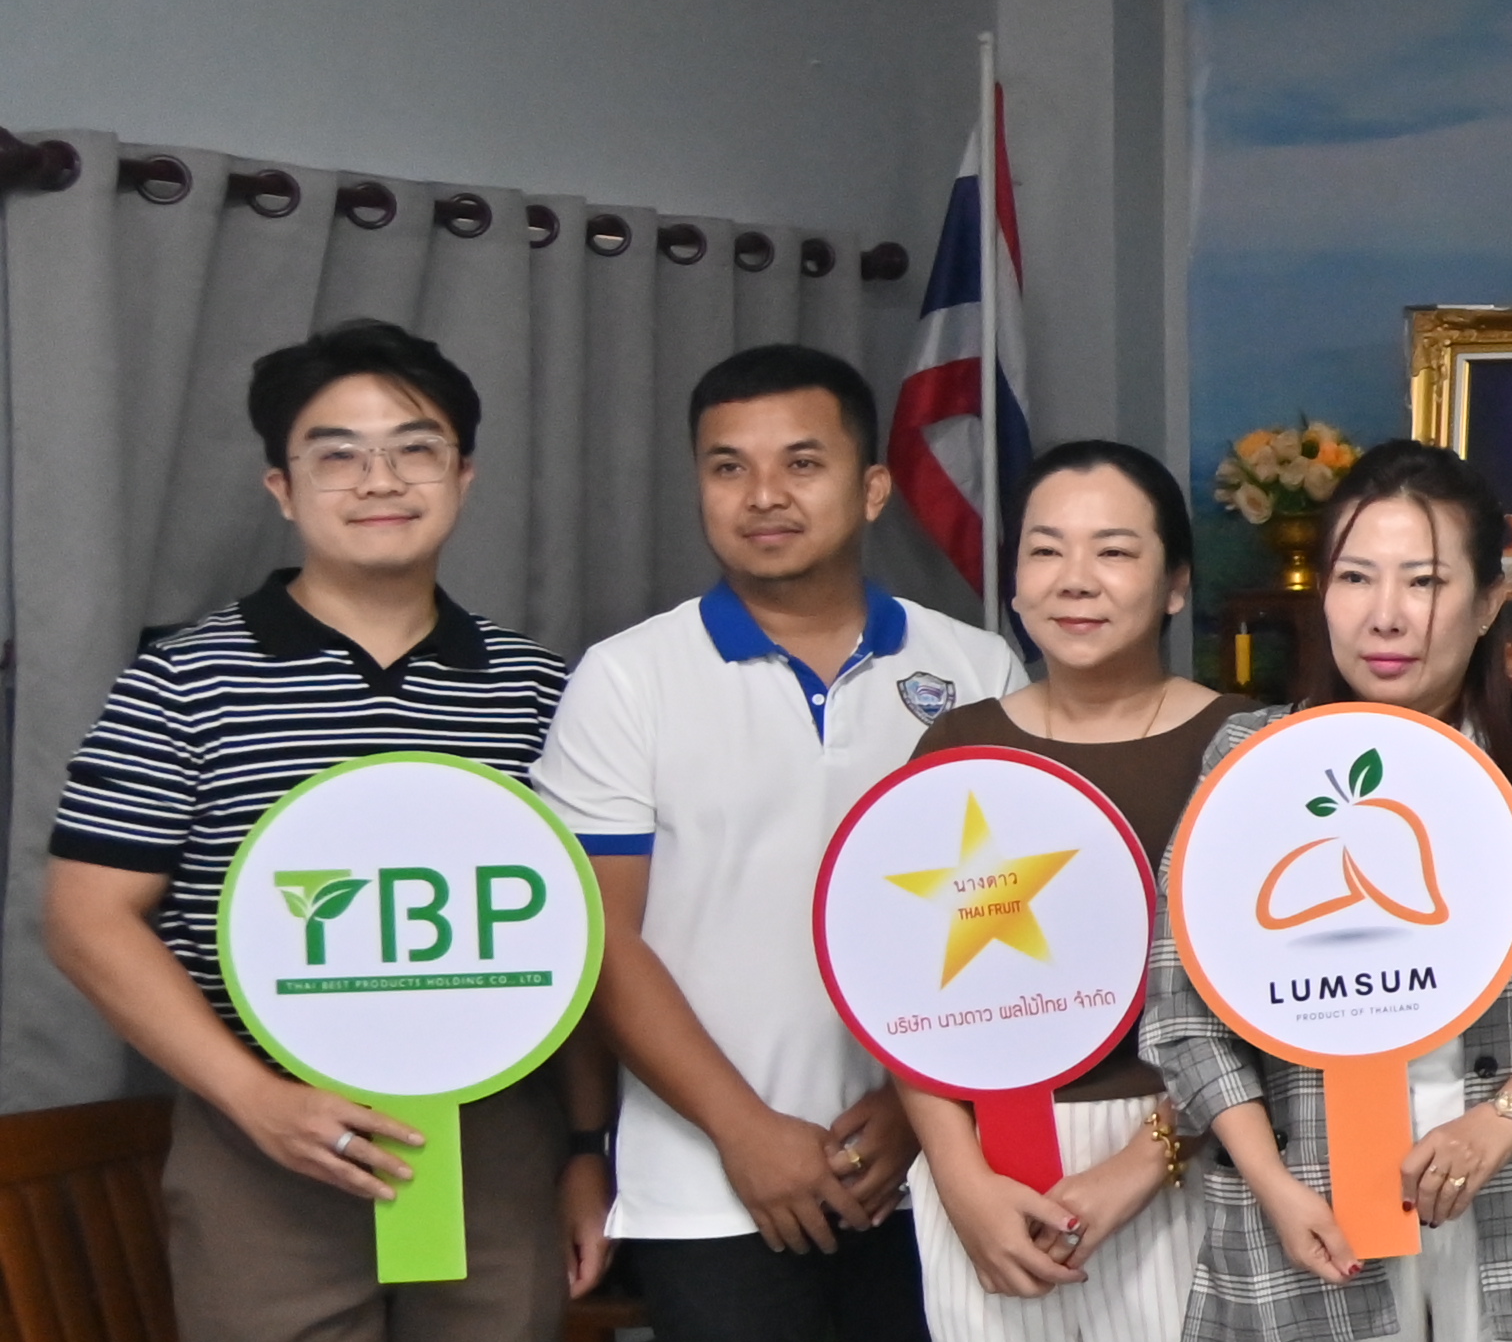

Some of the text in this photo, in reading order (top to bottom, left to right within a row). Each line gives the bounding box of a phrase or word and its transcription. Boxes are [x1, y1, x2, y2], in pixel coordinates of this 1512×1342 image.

[953, 871, 1018, 893] นางดาว
[958, 900, 1021, 920] THAI FRUIT
[286, 981, 317, 991] THAI
[321, 979, 349, 991] BEST
[355, 978, 421, 989] PRODUCTS
[426, 975, 485, 987] HOLDING
[1269, 965, 1438, 1005] LUMSUM
[886, 988, 1117, 1036] บริษัท นางดาว ผลไม้ไทย จำกัด
[1296, 1002, 1420, 1022] PRODUCT OF THAILAND
